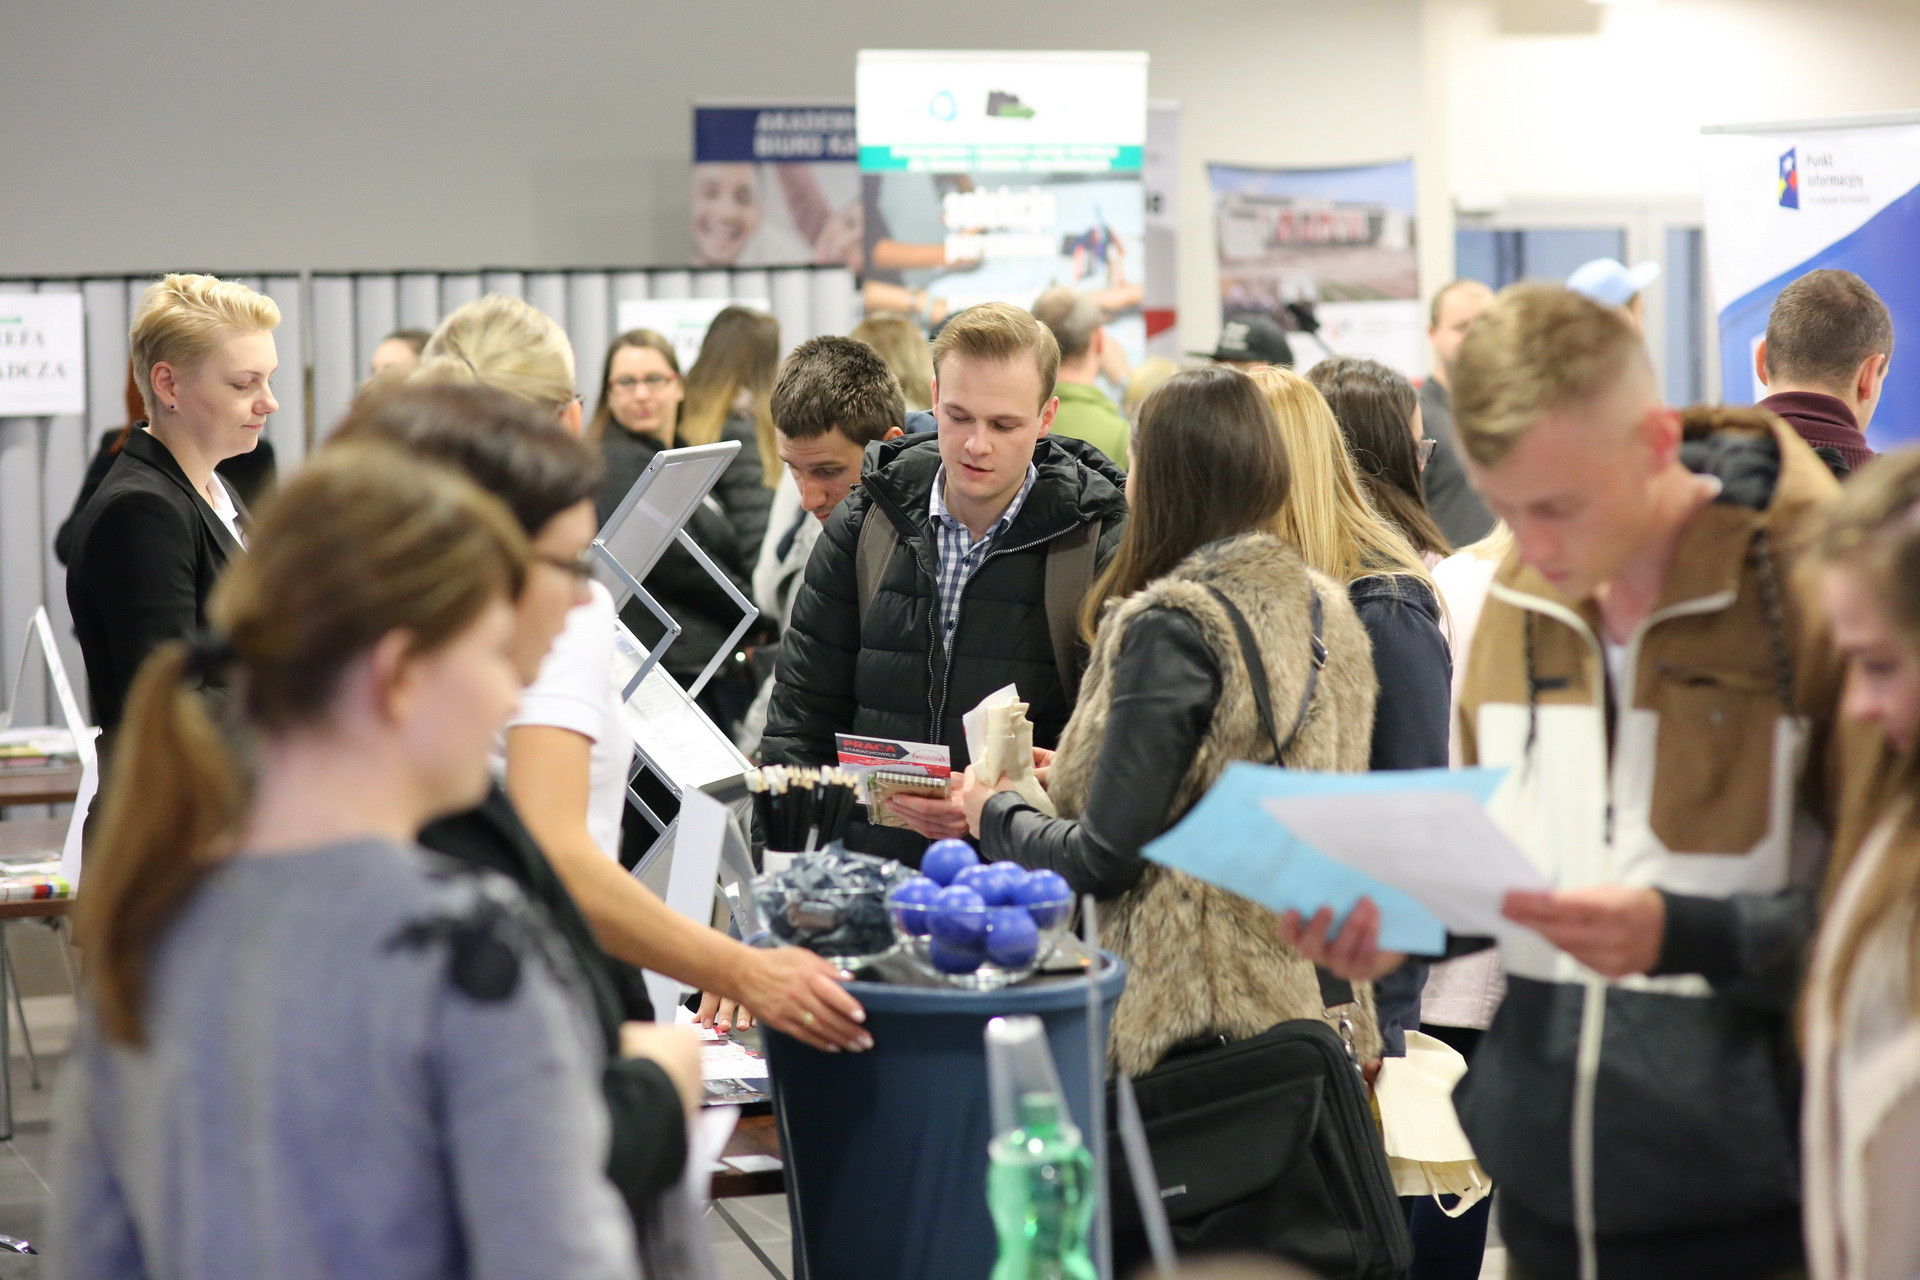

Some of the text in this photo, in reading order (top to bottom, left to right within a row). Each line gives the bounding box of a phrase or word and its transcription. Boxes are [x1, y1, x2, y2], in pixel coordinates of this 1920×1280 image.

[1806, 152, 1833, 168] Punkt
[0, 329, 47, 347] EFA
[842, 739, 897, 753] PRACA
[843, 746, 898, 758] STARACHOWICE
